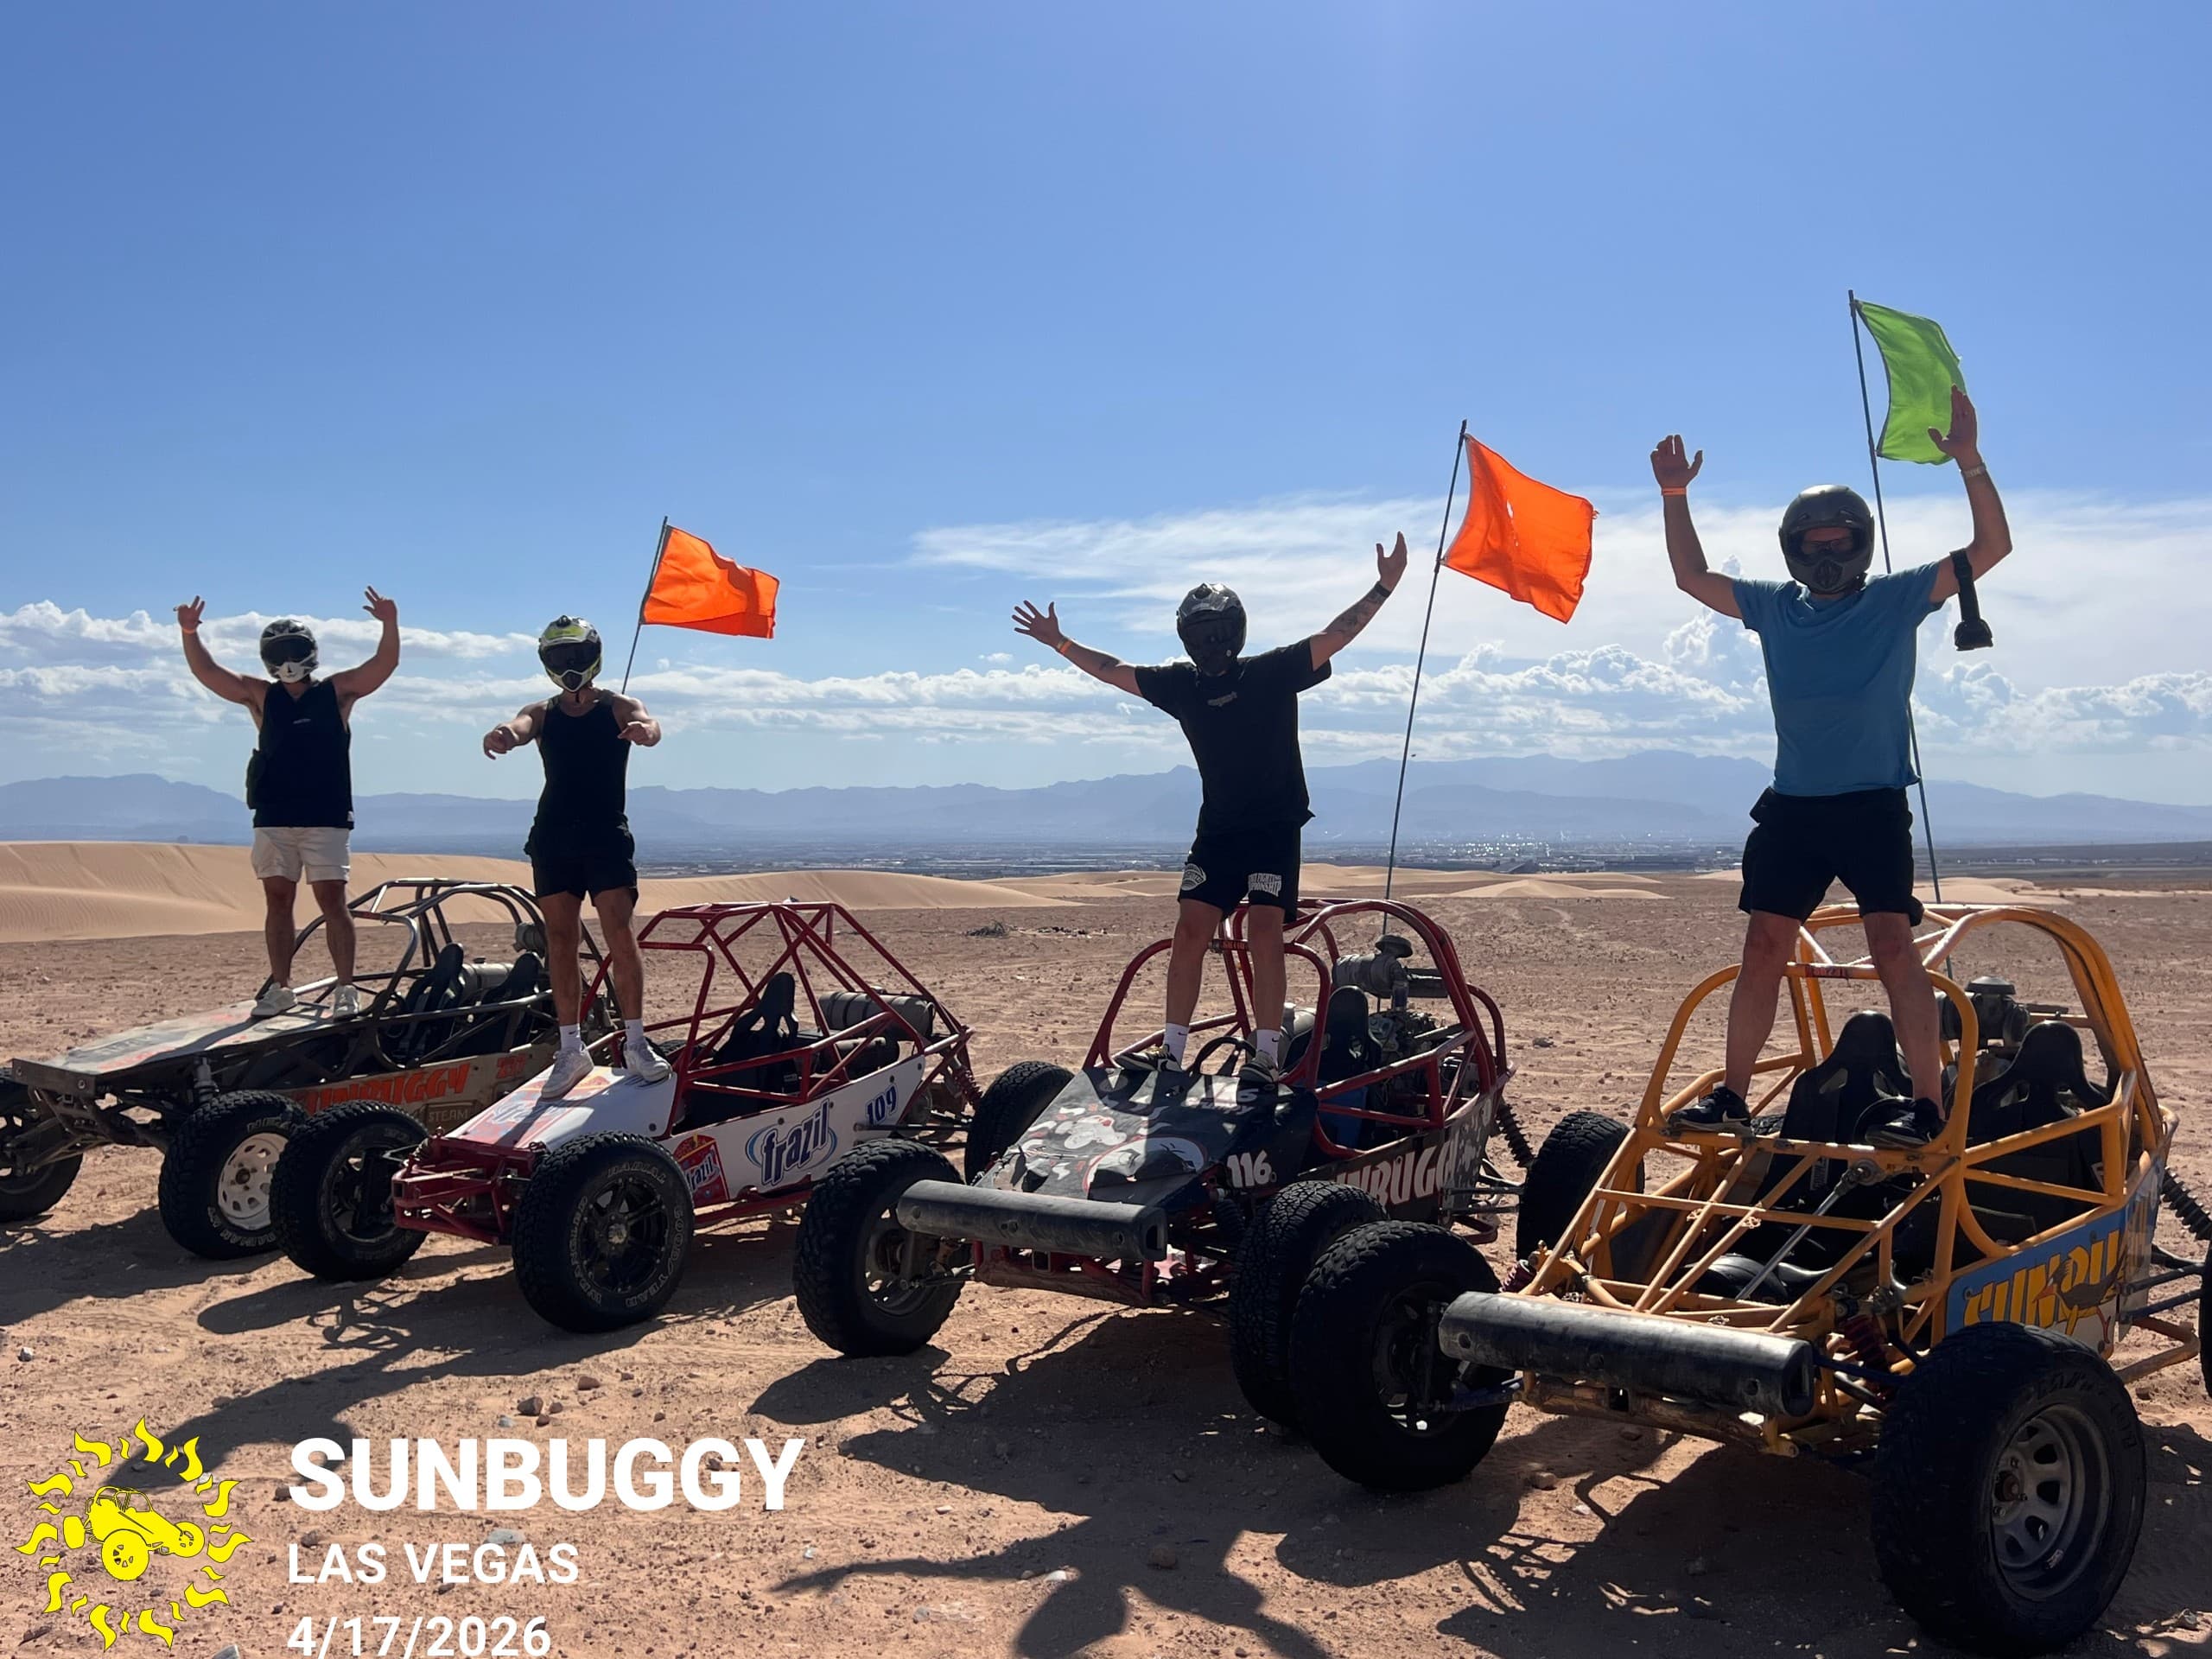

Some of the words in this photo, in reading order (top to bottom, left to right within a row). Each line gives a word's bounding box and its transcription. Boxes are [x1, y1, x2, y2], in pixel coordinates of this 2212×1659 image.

[866, 1084, 898, 1125] 109
[761, 1098, 830, 1185] frazil
[1227, 1150, 1271, 1188] 116
